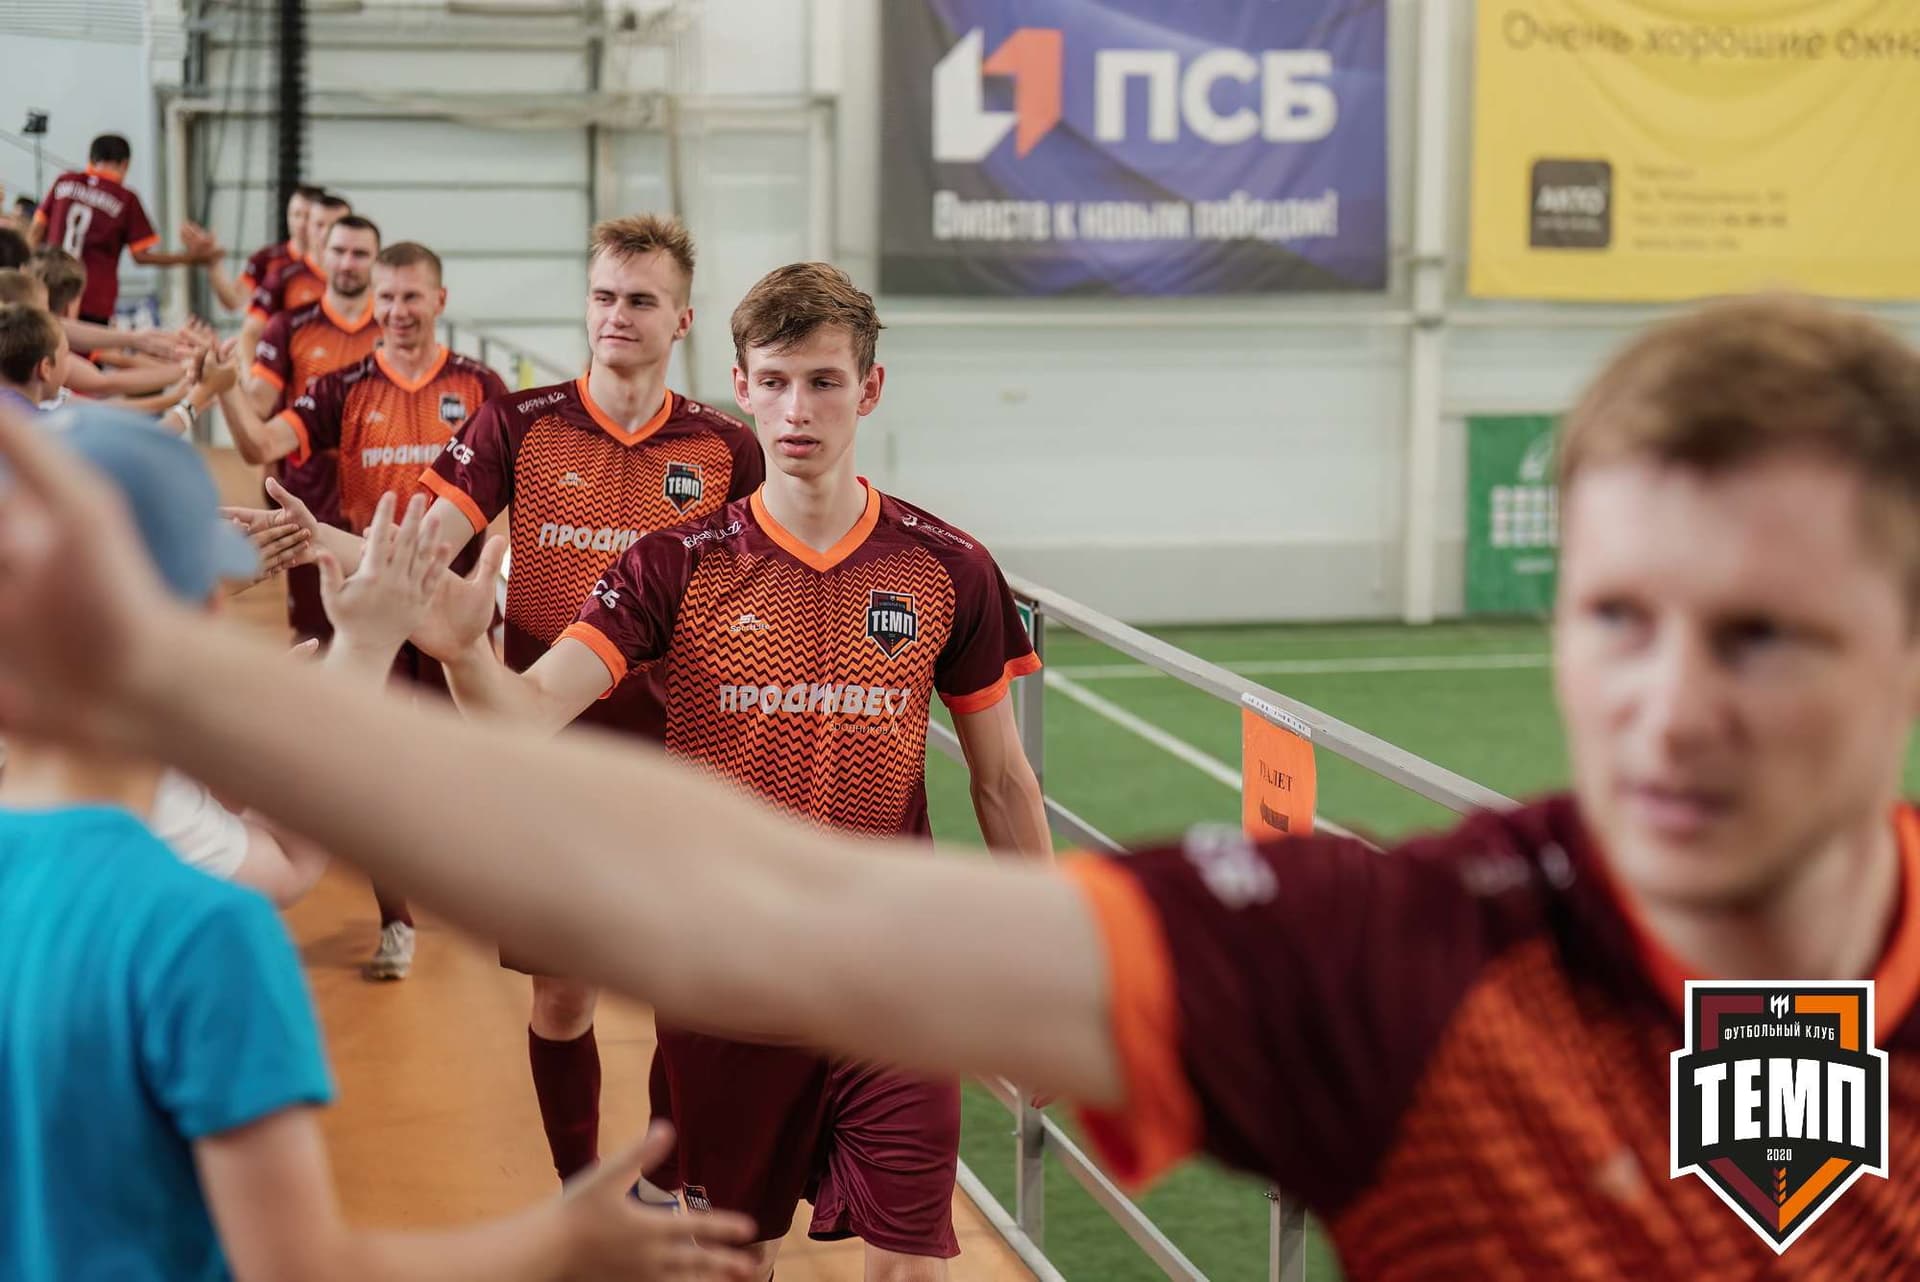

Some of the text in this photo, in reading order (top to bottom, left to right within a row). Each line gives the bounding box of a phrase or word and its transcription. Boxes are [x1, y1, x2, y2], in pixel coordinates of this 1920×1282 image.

[1094, 48, 1339, 145] ПСБ
[667, 476, 700, 498] ТЕМП
[591, 579, 621, 609] СБ
[871, 609, 913, 637] ТЕМП
